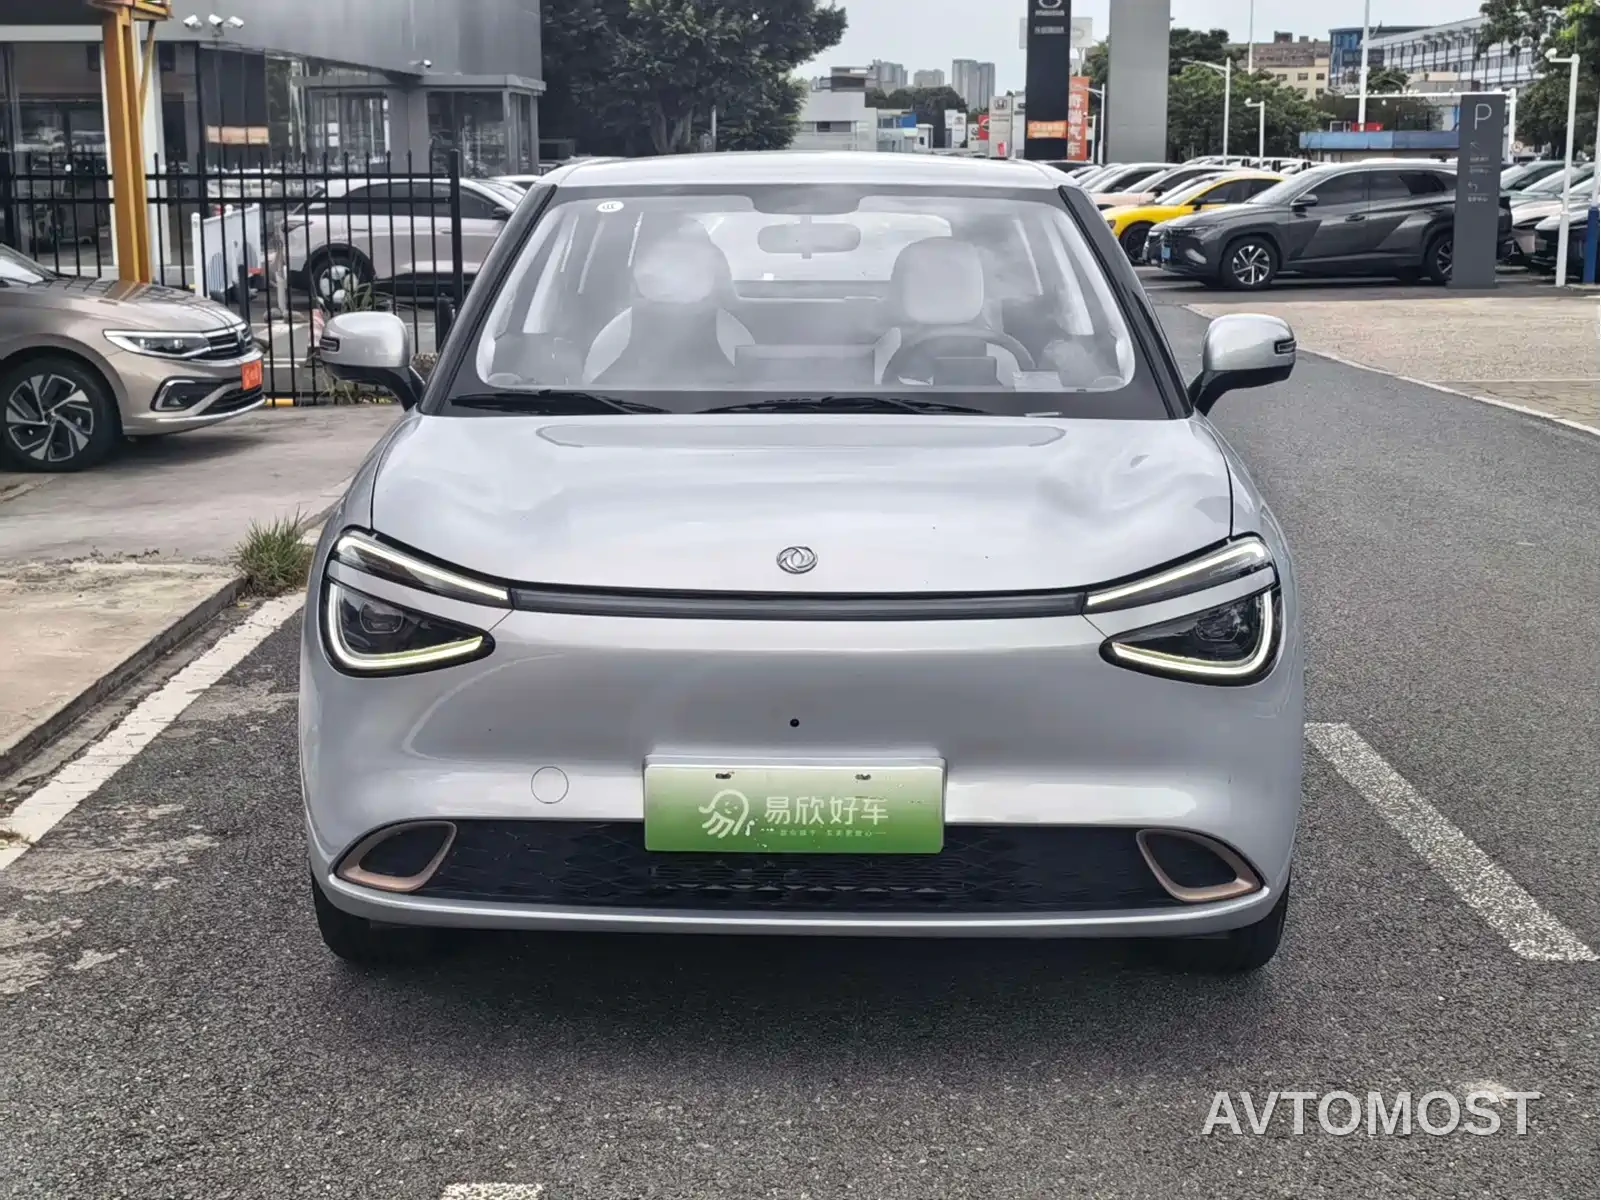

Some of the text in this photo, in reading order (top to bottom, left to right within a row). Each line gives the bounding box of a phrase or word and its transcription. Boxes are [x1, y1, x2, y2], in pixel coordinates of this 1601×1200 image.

[1474, 103, 1492, 130] P
[764, 796, 889, 825] 易欣好车
